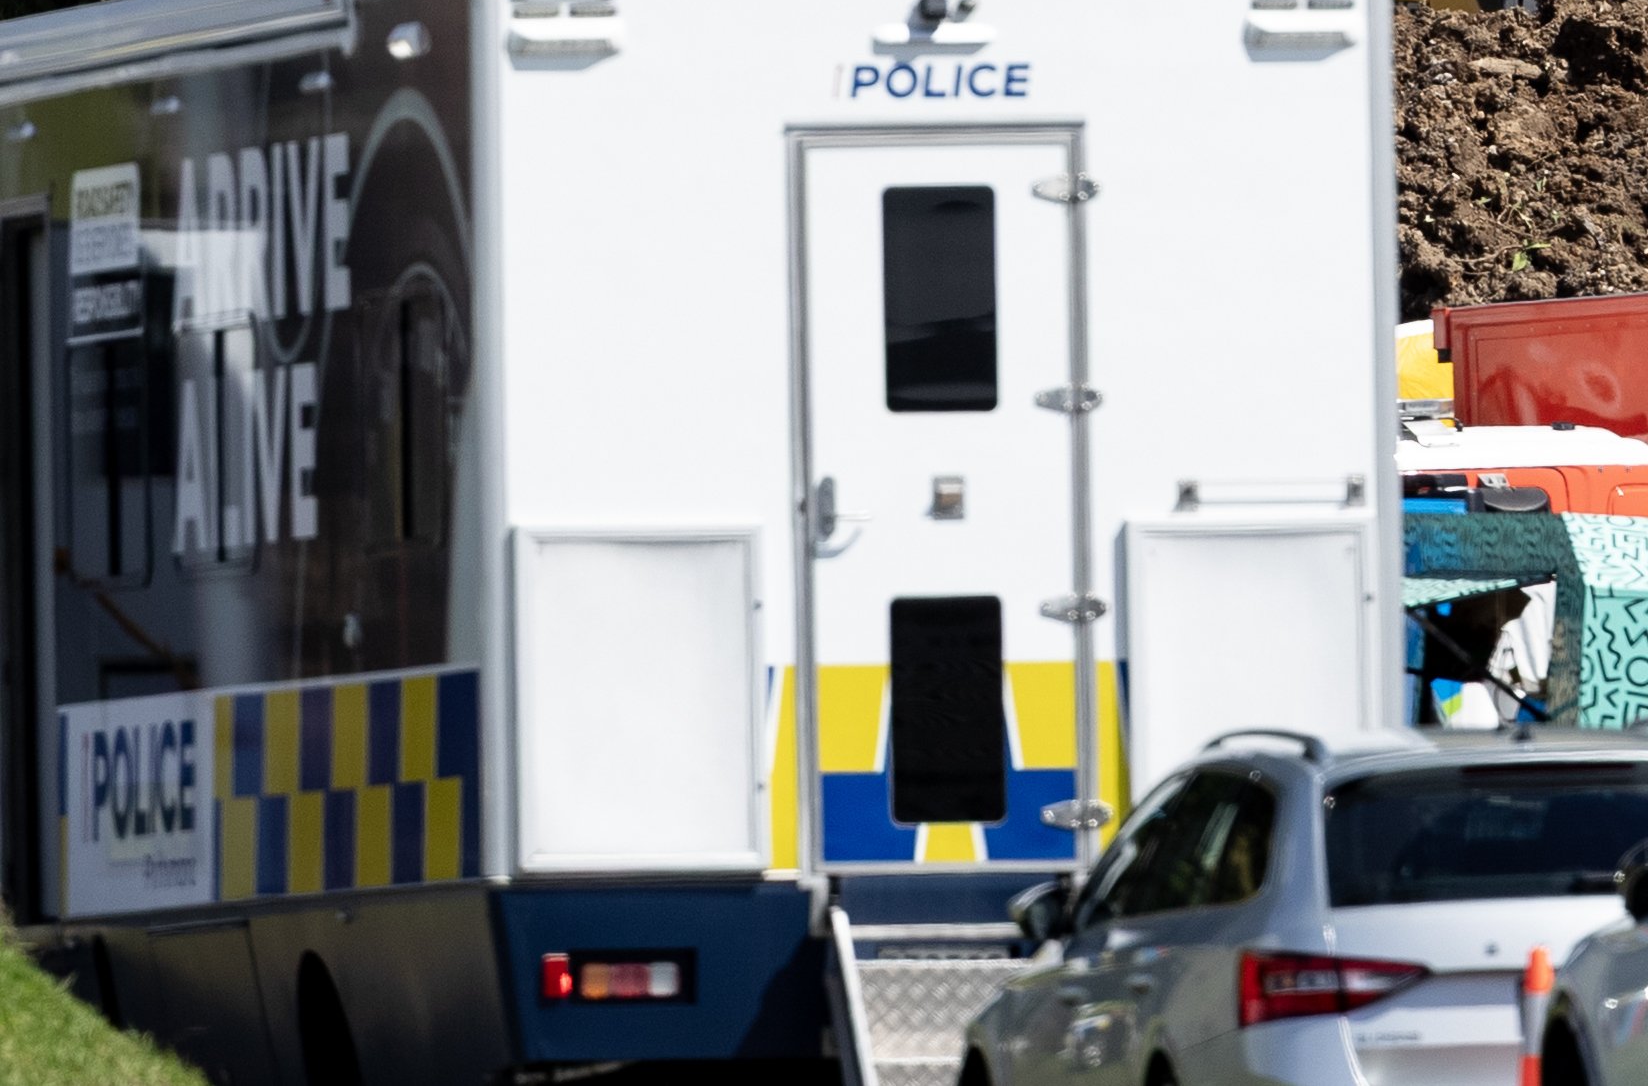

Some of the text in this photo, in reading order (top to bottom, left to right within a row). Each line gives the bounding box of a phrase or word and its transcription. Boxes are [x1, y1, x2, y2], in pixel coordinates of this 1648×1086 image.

[851, 63, 1030, 98] POLICE
[174, 133, 351, 334] ARRIVE
[173, 361, 318, 555] ALIVE
[92, 719, 196, 843] POLICE
